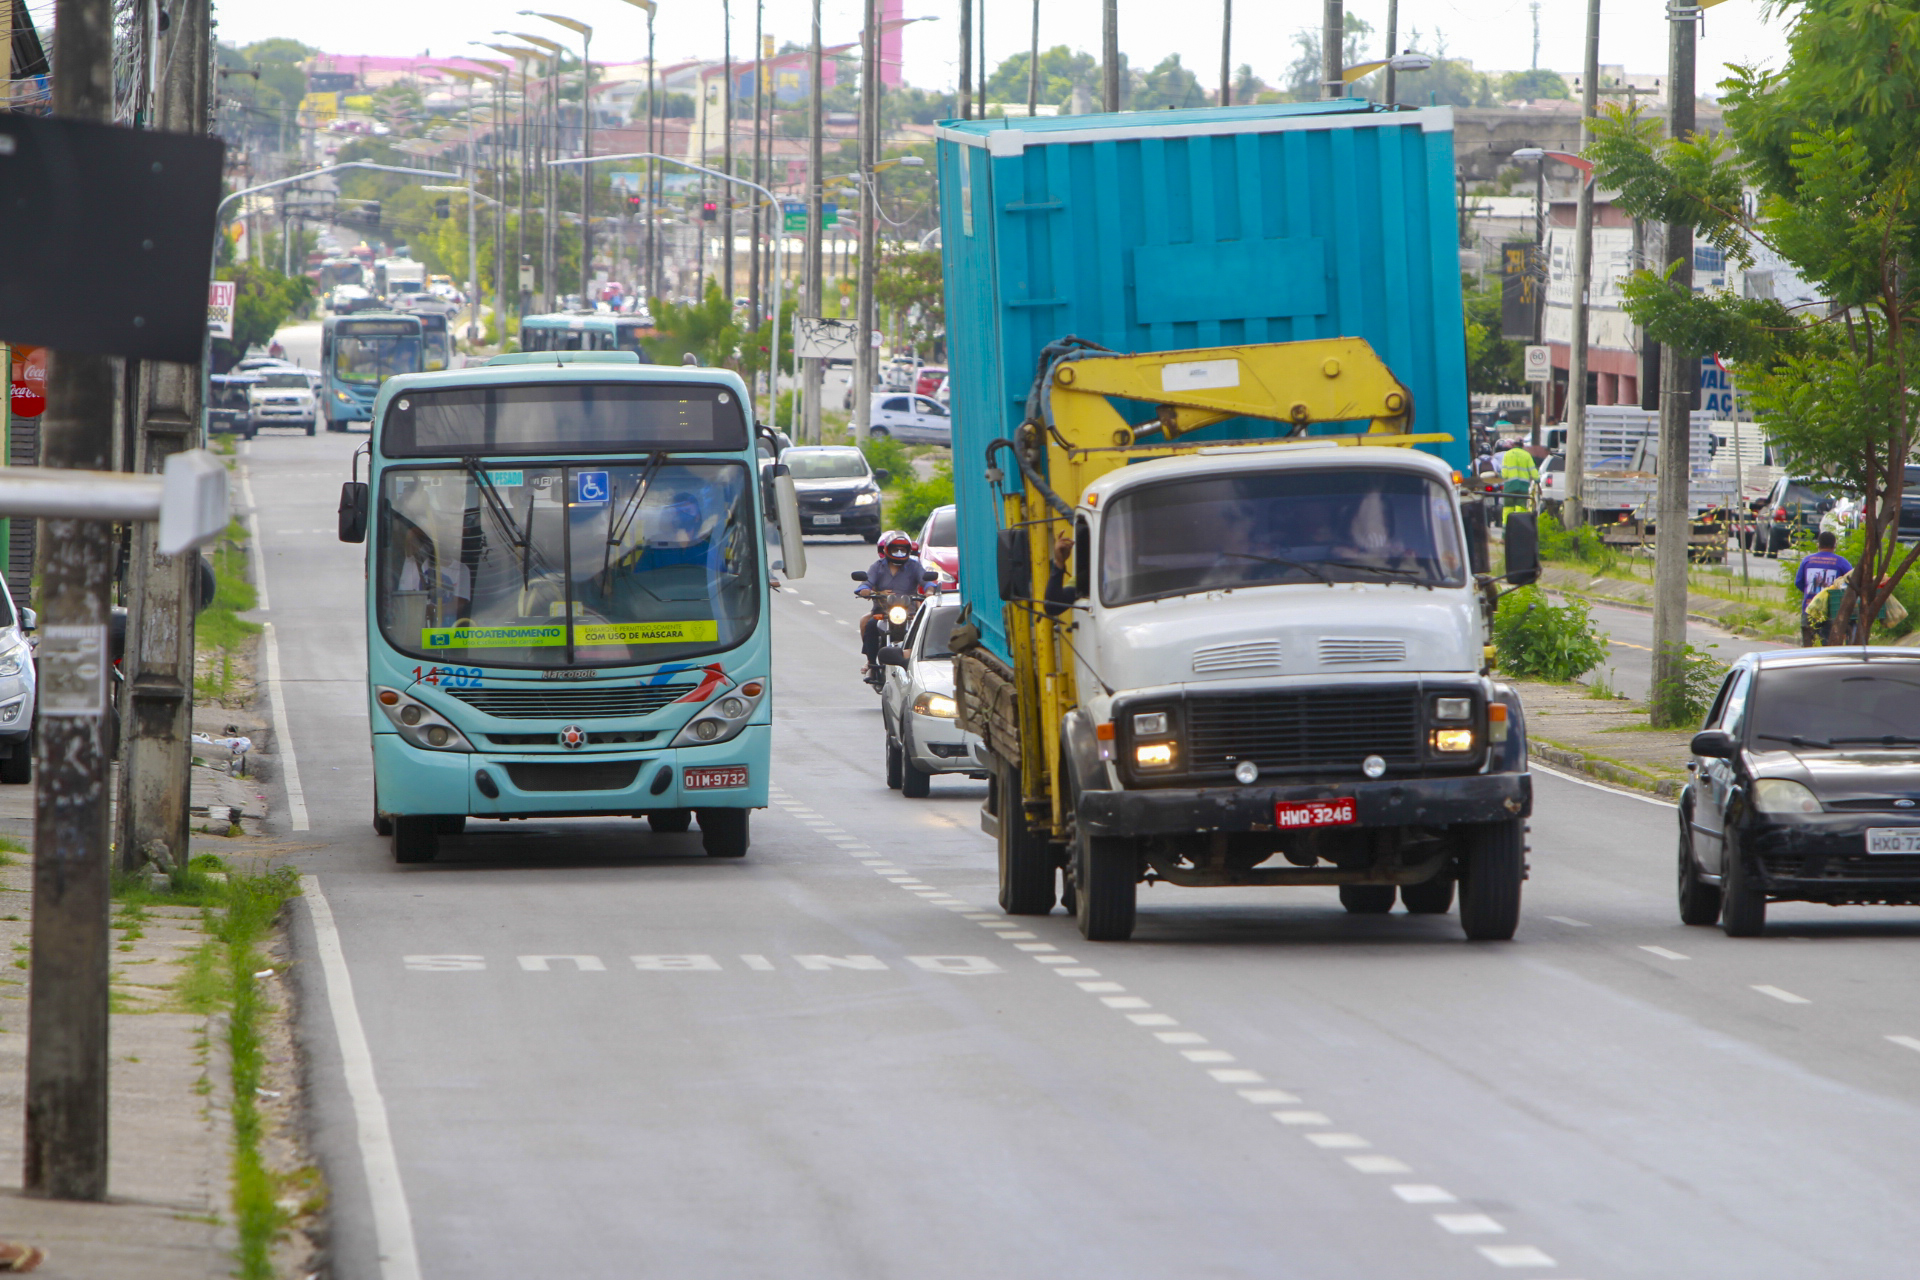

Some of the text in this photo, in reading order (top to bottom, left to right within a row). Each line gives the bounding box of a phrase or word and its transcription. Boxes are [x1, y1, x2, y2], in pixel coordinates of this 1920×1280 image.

[1532, 352, 1544, 360] 60
[454, 628, 560, 639] AUTOATENDIMENTO
[608, 632, 626, 640] USO
[641, 629, 683, 638] MÁSCARA
[412, 666, 483, 687] 14202
[542, 670, 598, 679] Marcopolo
